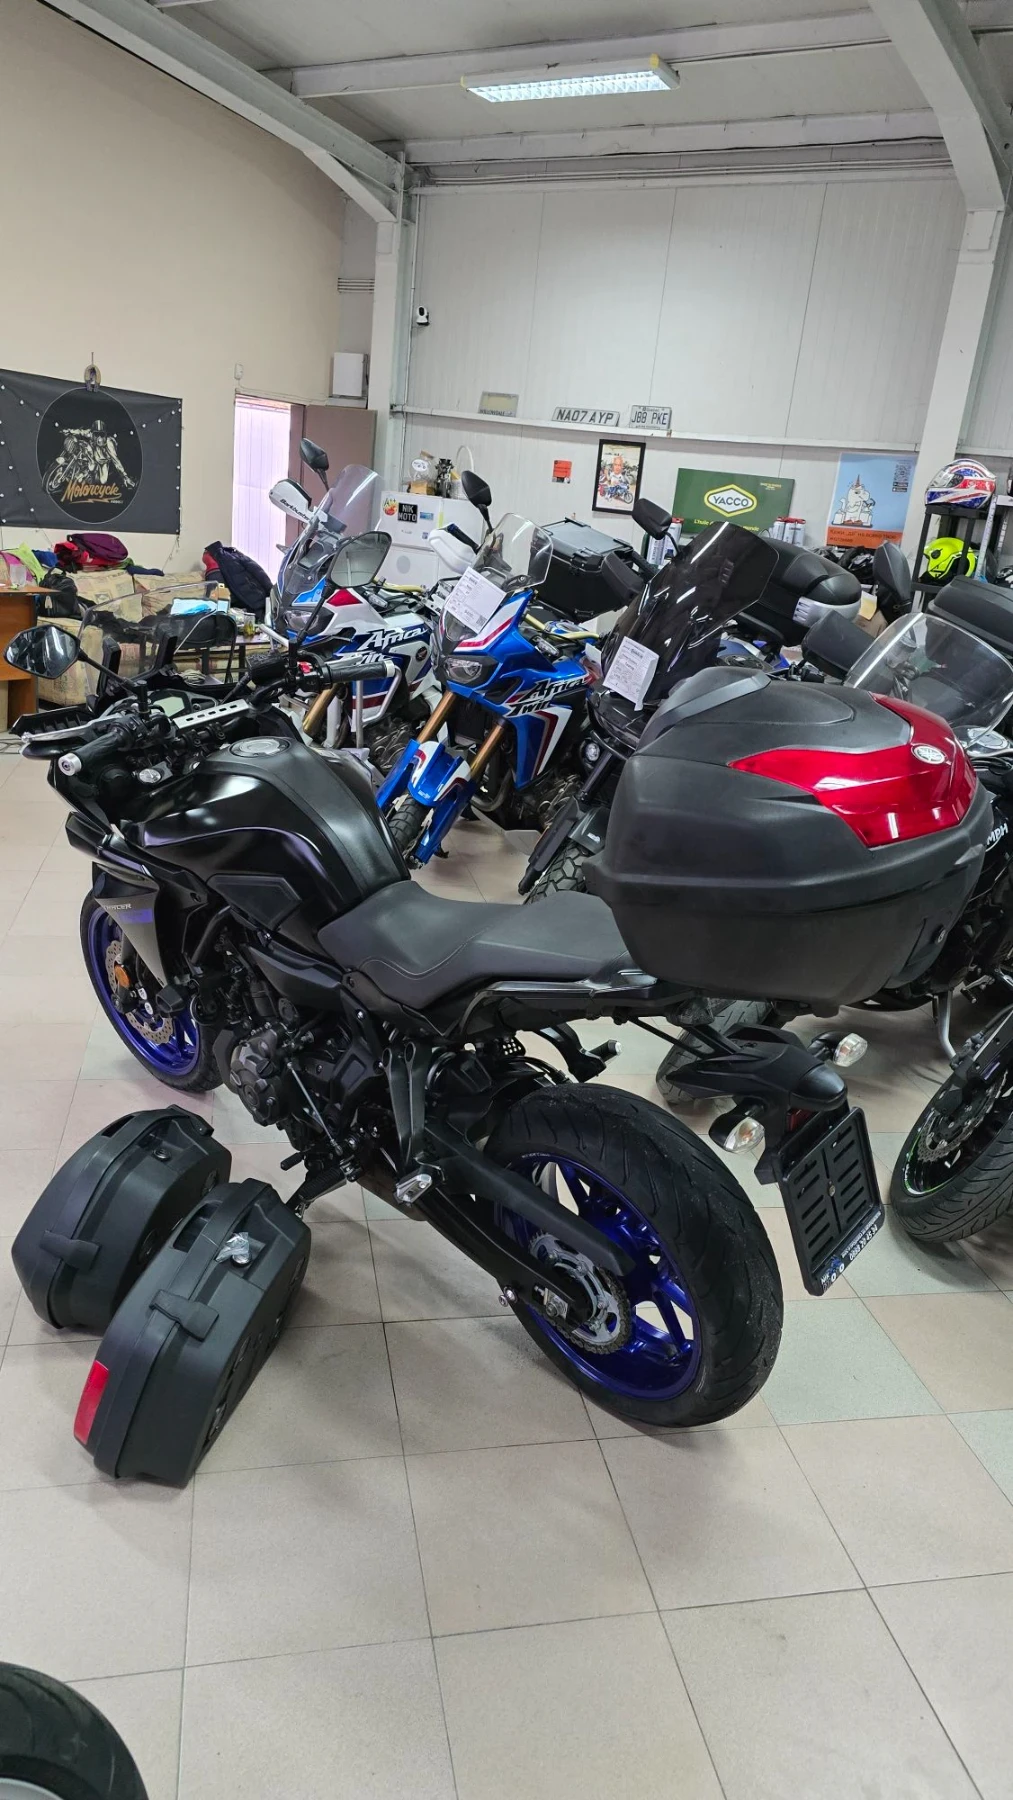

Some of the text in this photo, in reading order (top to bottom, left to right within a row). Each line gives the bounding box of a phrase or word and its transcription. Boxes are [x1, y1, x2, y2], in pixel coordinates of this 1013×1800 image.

[556, 408, 614, 424] NA07 AYP
[651, 412, 669, 426] PKE
[60, 480, 122, 502] Motorcycle
[402, 504, 414, 514] NIK
[713, 495, 749, 507] YACCO
[398, 512, 418, 522] MOTO
[357, 626, 428, 652] Africa
[518, 678, 588, 703] Africa
[507, 700, 551, 717] Twin
[986, 822, 1009, 846] MPH
